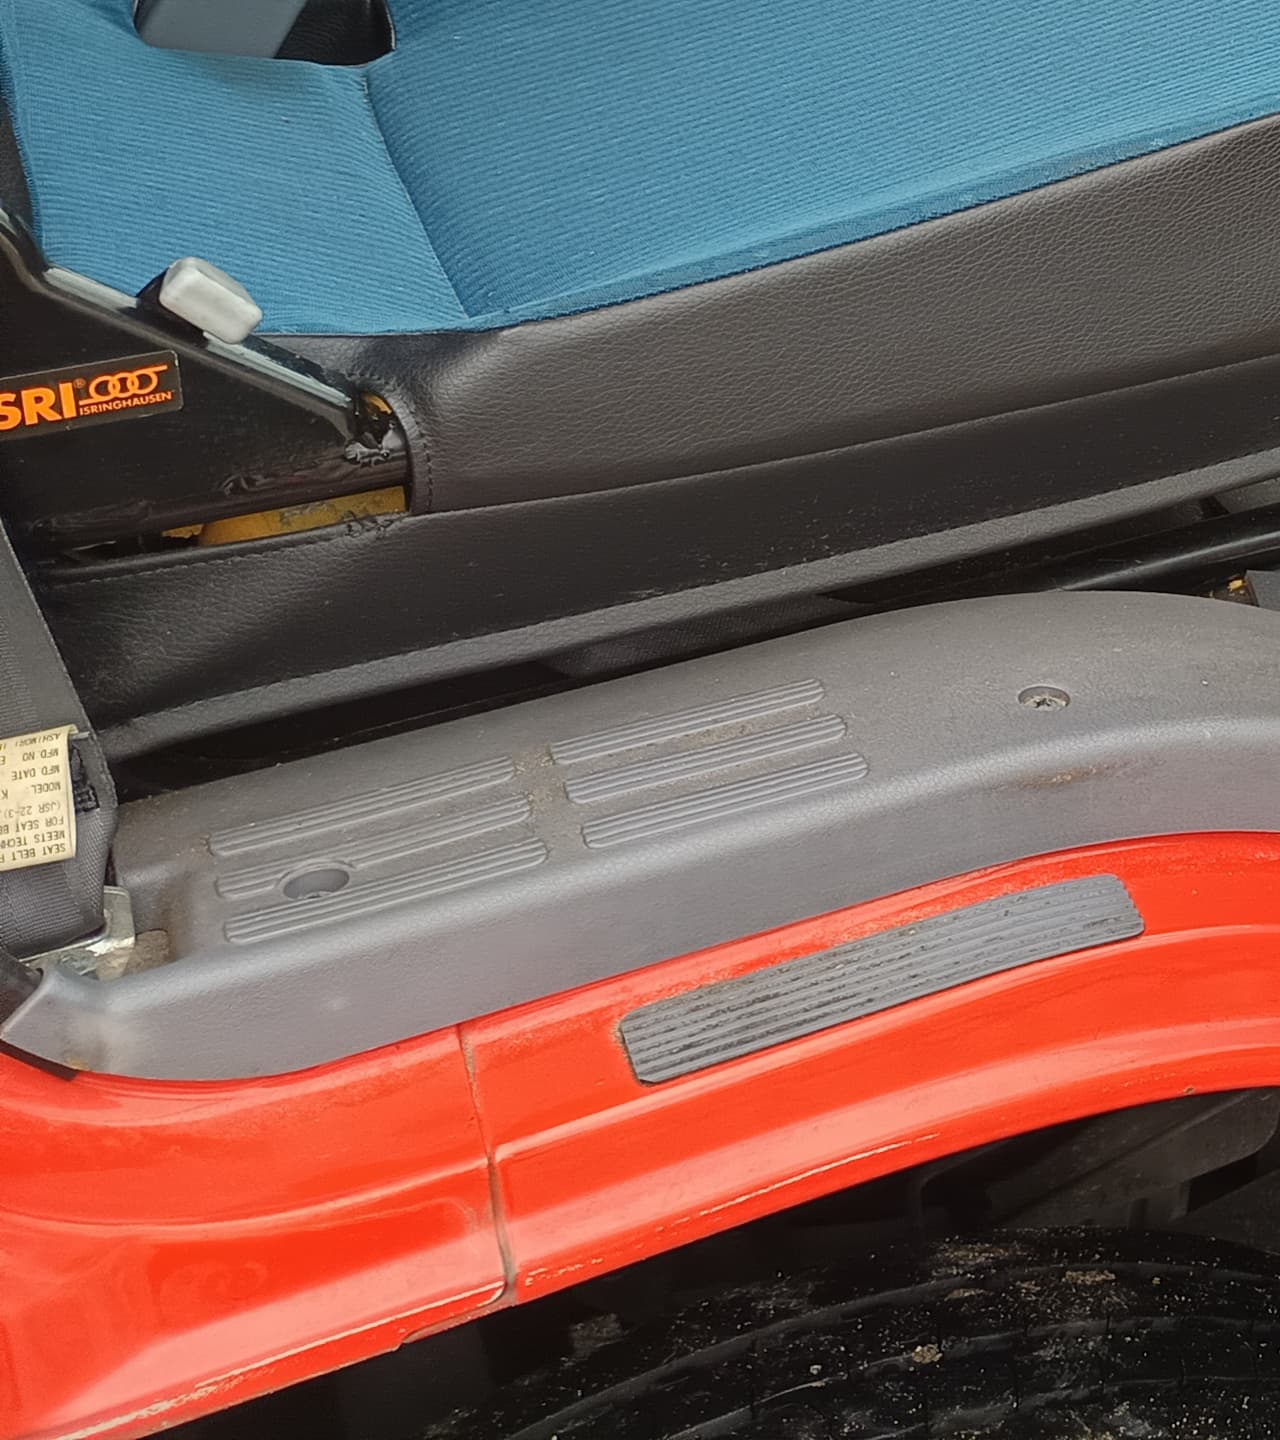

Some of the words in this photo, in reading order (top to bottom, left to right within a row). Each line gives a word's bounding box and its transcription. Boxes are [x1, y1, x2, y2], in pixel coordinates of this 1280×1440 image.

[79, 391, 172, 416] ISRINGHAUSEN
[22, 752, 35, 762] NO
[11, 768, 36, 781] DATE
[32, 782, 61, 794] MODEL
[16, 820, 39, 832] SEAT
[45, 816, 64, 828] FOR
[34, 831, 65, 844] MEETS
[12, 848, 36, 861] BELT
[42, 843, 66, 856] SEAT
